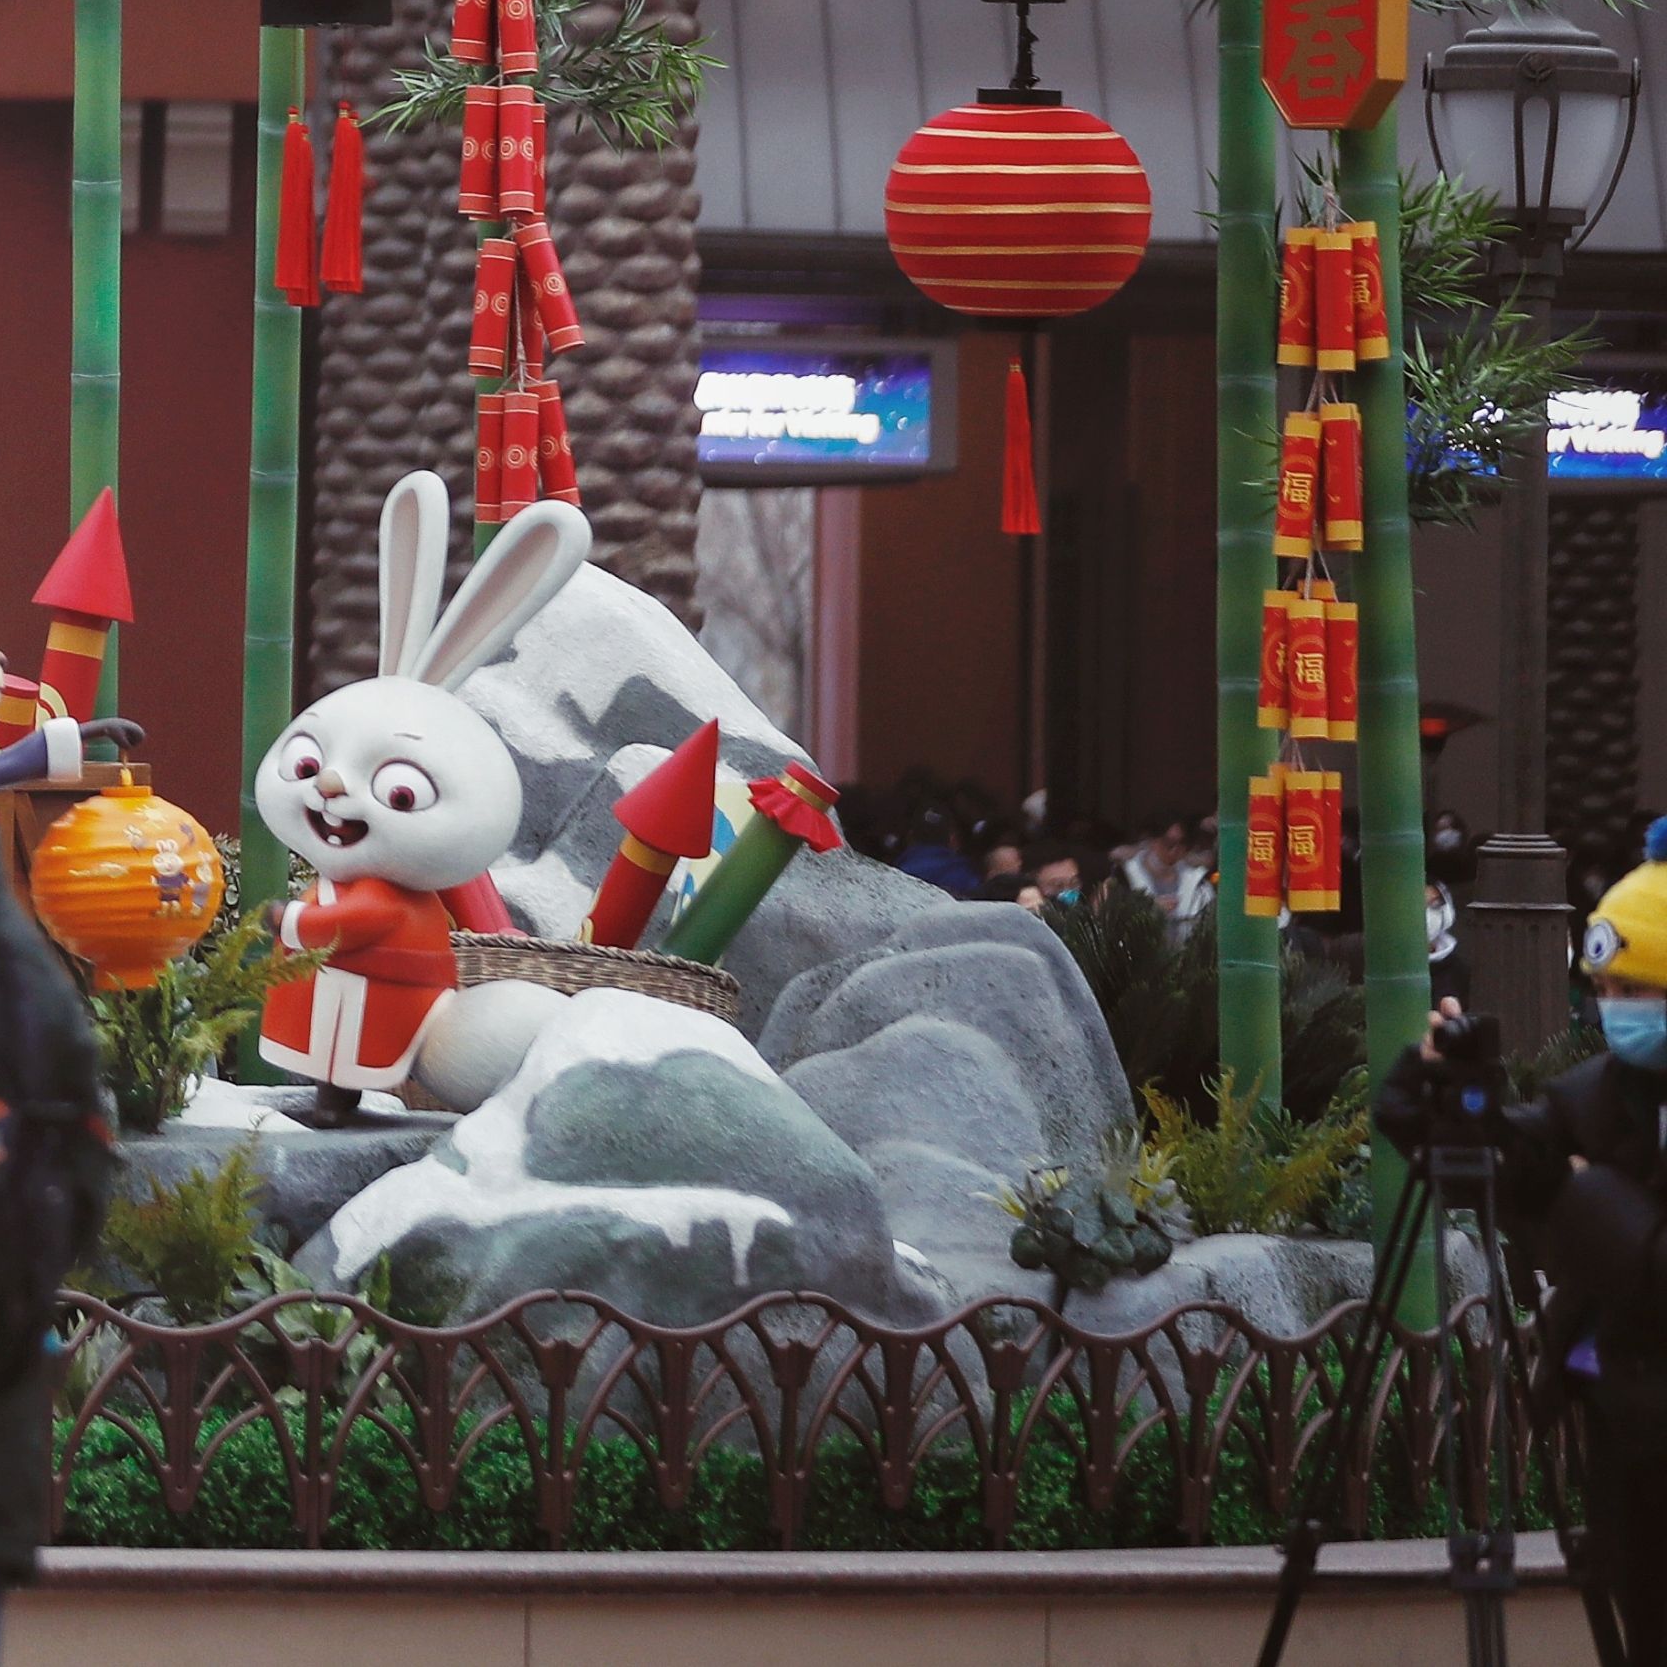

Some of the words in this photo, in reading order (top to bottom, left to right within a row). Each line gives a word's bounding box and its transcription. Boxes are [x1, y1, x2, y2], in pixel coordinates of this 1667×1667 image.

[1282, 470, 1314, 504] 福
[1295, 651, 1325, 685] 福
[1248, 829, 1276, 862] 福
[1288, 825, 1316, 856] 福
